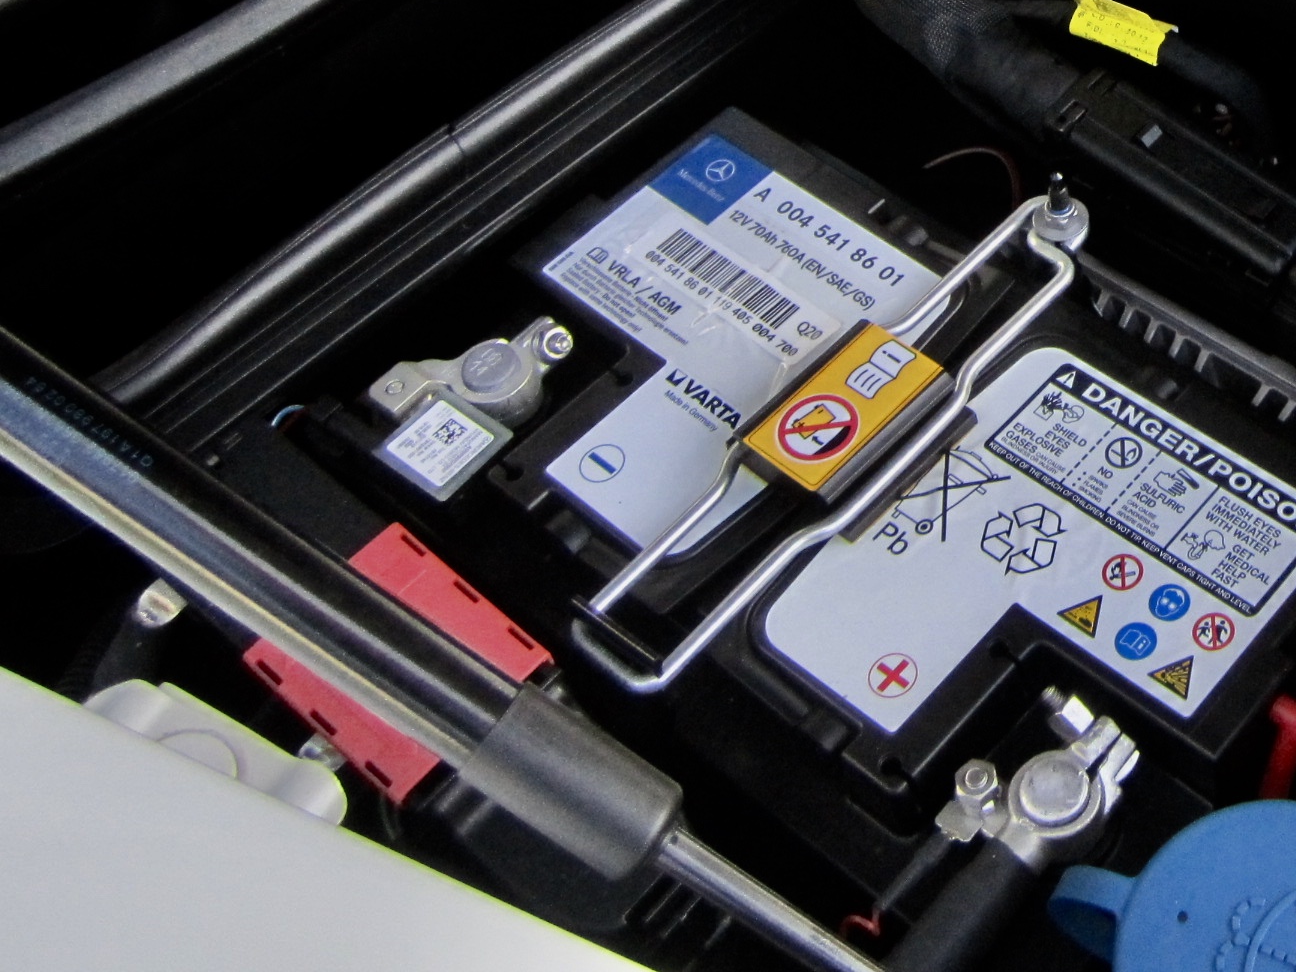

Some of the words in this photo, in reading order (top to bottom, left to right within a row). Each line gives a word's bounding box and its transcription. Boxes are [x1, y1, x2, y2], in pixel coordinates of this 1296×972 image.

[677, 168, 725, 202] Mercedes-Benz
[753, 187, 772, 203] A
[777, 201, 814, 228] 004
[814, 224, 850, 251] 541
[850, 248, 878, 269] 86
[878, 266, 905, 287] 01
[729, 210, 754, 227] 12V
[748, 222, 778, 246] 70Ah
[775, 239, 806, 264] 760A
[801, 258, 875, 310] (EN/SAE/GS)
[608, 260, 641, 288] VRLA
[648, 291, 682, 315] AGM
[645, 250, 666, 266] 004
[664, 263, 685, 280] 541
[683, 277, 700, 290] 86
[697, 286, 714, 299] 01
[713, 296, 733, 311] 119
[732, 308, 752, 325] 405
[752, 323, 776, 342] 004
[775, 339, 799, 356] 700
[796, 321, 823, 340] Q20
[664, 389, 683, 405] Made
[682, 402, 691, 411] in
[689, 406, 720, 432] Germany
[683, 378, 743, 429] VARTA
[1006, 430, 1038, 454] GASES
[1013, 422, 1064, 457] EXPLOSIVE
[1044, 430, 1071, 450] EYES
[1052, 423, 1087, 447] SHIELD
[1083, 480, 1104, 496] FLAMES
[1097, 466, 1114, 480] NO
[1132, 491, 1157, 508] ACID
[1140, 483, 1185, 514] SULFURIC
[988, 441, 1007, 455] KEEP
[1005, 453, 1021, 464] OUT
[1018, 461, 1030, 469] OF
[1028, 466, 1043, 479] THE
[1041, 475, 1064, 492] REACH
[1062, 489, 1074, 497] OF
[1104, 516, 1117, 526] DO
[1115, 523, 1131, 535] NOT
[1141, 539, 1160, 553] KEEP
[1159, 550, 1178, 565] VENT
[1176, 562, 1196, 577] CAPS
[1196, 574, 1217, 590] TIGHT
[1215, 587, 1231, 600] AND
[1205, 511, 1233, 533] WITH
[1233, 528, 1270, 556] WATER
[1211, 504, 1281, 549] IMMEDIATELY
[1218, 496, 1254, 521] FLUSH
[1252, 517, 1282, 538] EYES
[872, 521, 909, 556] Pb
[1232, 544, 1255, 561] GET
[1211, 567, 1239, 588] FAST
[1217, 559, 1247, 580] HELP
[1225, 551, 1270, 585] MEDICAL
